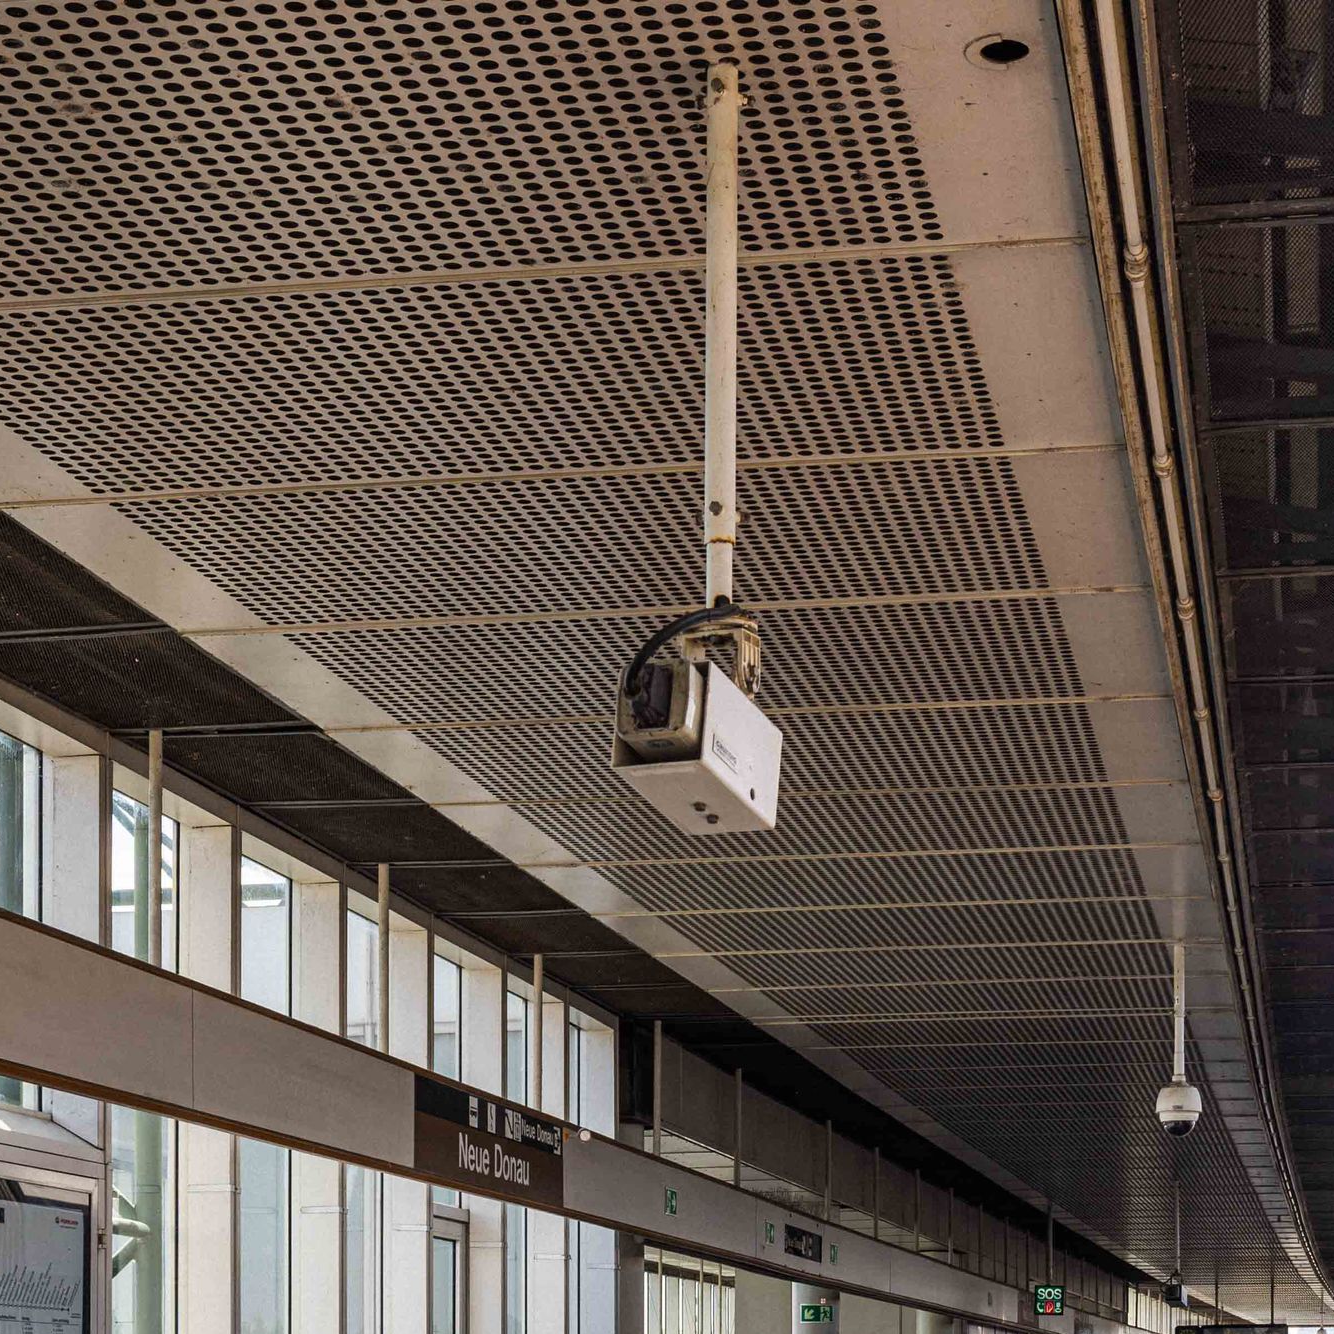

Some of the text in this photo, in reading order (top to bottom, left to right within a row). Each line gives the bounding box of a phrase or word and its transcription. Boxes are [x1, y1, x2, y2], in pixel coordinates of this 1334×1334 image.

[521, 1118, 554, 1146] Neue Donau
[459, 1132, 530, 1186] Neue Donau
[1037, 1288, 1062, 1300] SOS
